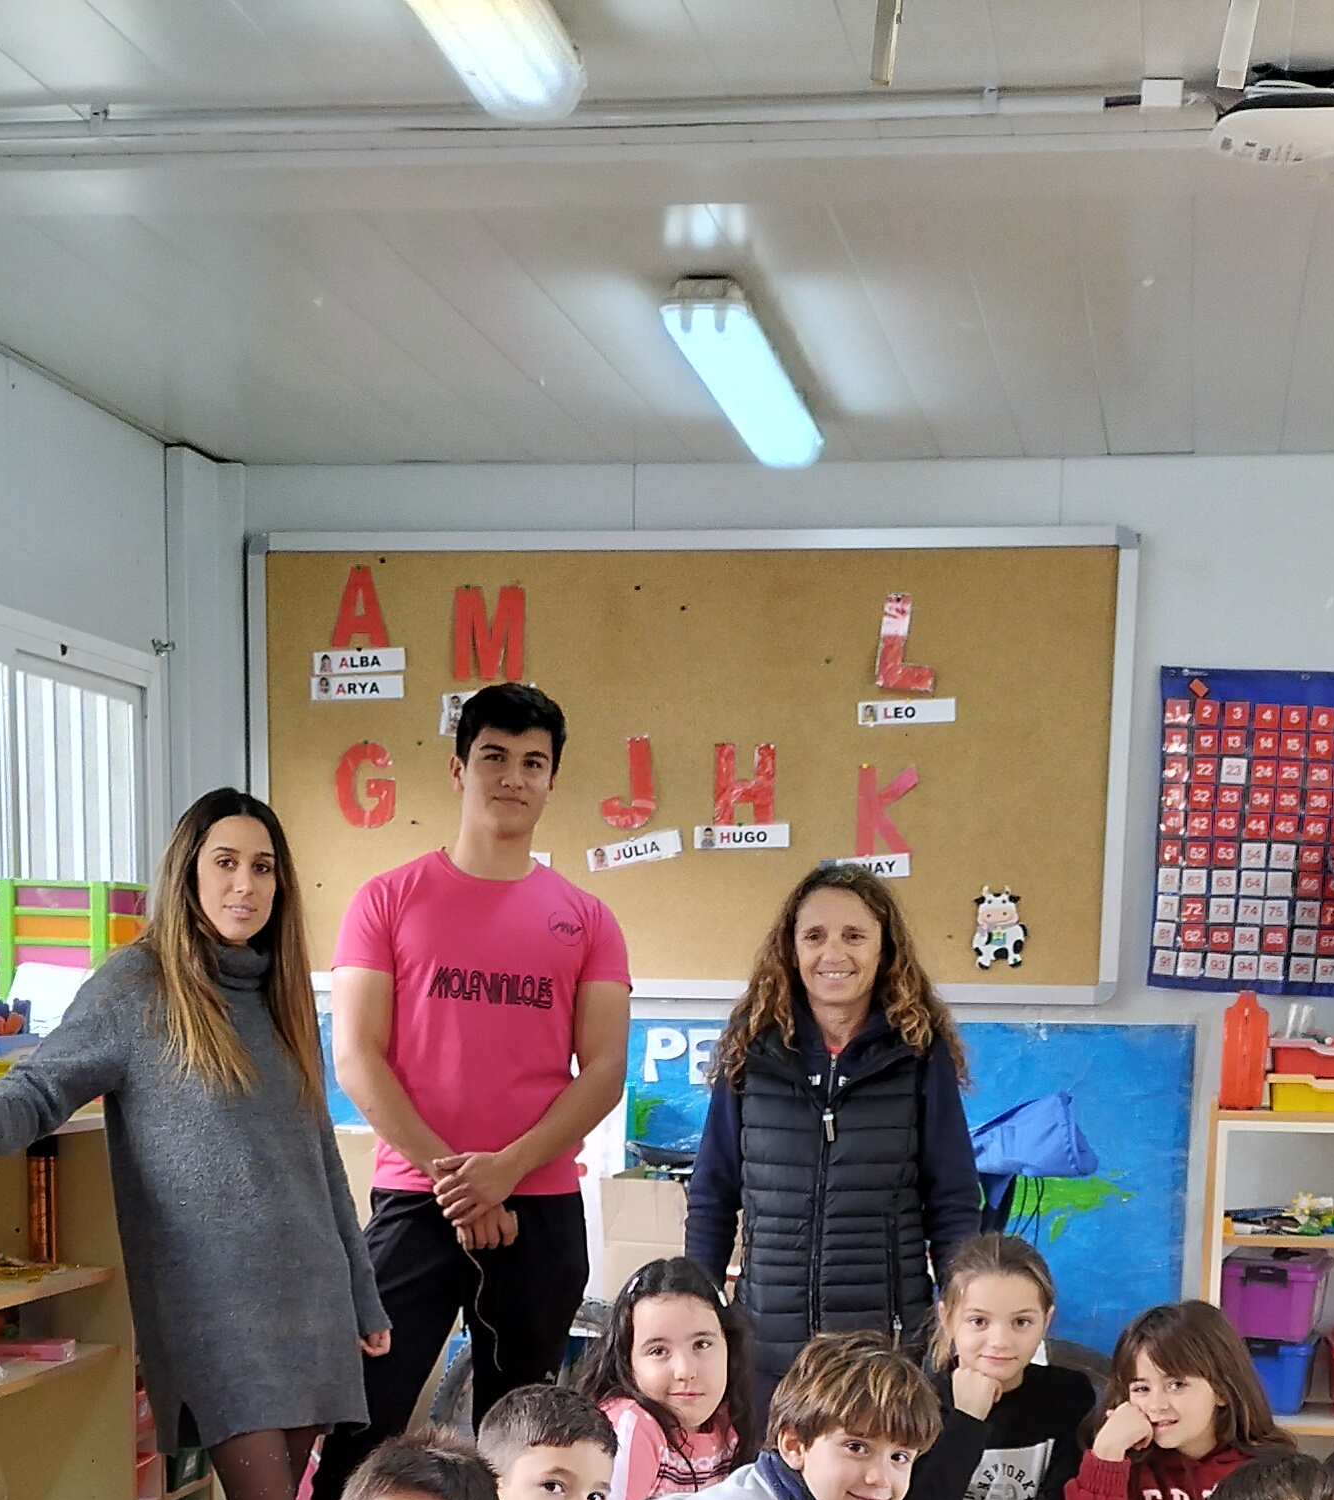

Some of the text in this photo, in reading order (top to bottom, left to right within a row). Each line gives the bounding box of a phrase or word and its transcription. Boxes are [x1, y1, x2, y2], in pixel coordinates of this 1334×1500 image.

[331, 565, 390, 648] A
[453, 585, 526, 681] M
[875, 592, 935, 692] L
[338, 655, 381, 669] ALBA
[335, 682, 380, 696] ARYA
[883, 706, 916, 720] LEO
[1200, 735, 1214, 748] 12
[1227, 735, 1241, 748] 13
[1259, 736, 1274, 749] 14
[1315, 740, 1329, 754] 16
[1196, 763, 1214, 776] 22
[1226, 764, 1242, 776] 23
[1255, 765, 1273, 778] 24
[1282, 766, 1300, 779] 25
[1311, 768, 1328, 781] 26
[335, 741, 396, 829] G
[600, 734, 656, 829] J
[713, 743, 776, 825] H
[1193, 789, 1210, 803] 32
[1221, 790, 1239, 803] 33
[1252, 792, 1270, 805] 34
[1279, 793, 1298, 806] 35
[1310, 795, 1327, 808] 36
[855, 764, 918, 857] K
[1191, 816, 1209, 830] 42
[1218, 816, 1236, 830] 43
[1248, 818, 1266, 831] 44
[1276, 820, 1294, 834] 45
[1306, 822, 1325, 835] 46
[719, 831, 768, 844] HUGO
[613, 840, 661, 862] JÚLIA
[1189, 847, 1207, 860] 52
[1217, 847, 1235, 860] 53
[1302, 851, 1320, 864] 56
[863, 861, 895, 873] NAY
[1216, 876, 1231, 887] 63
[1245, 878, 1261, 888] 64
[1301, 878, 1319, 891] 66
[1163, 902, 1173, 913] 71
[1185, 903, 1202, 915] 72
[1215, 905, 1229, 915] 73
[1243, 906, 1257, 916] 74
[1268, 906, 1284, 917] 75
[1300, 907, 1316, 918] 76
[1159, 928, 1171, 938] 81
[1184, 930, 1201, 943] 82
[1212, 931, 1229, 943] 83
[1238, 933, 1254, 944] 84
[1266, 933, 1284, 944] 85
[1160, 956, 1172, 967] 91
[1210, 960, 1226, 971] 93
[1237, 961, 1253, 972] 94
[1263, 961, 1279, 972] 95
[1294, 963, 1309, 974] 96
